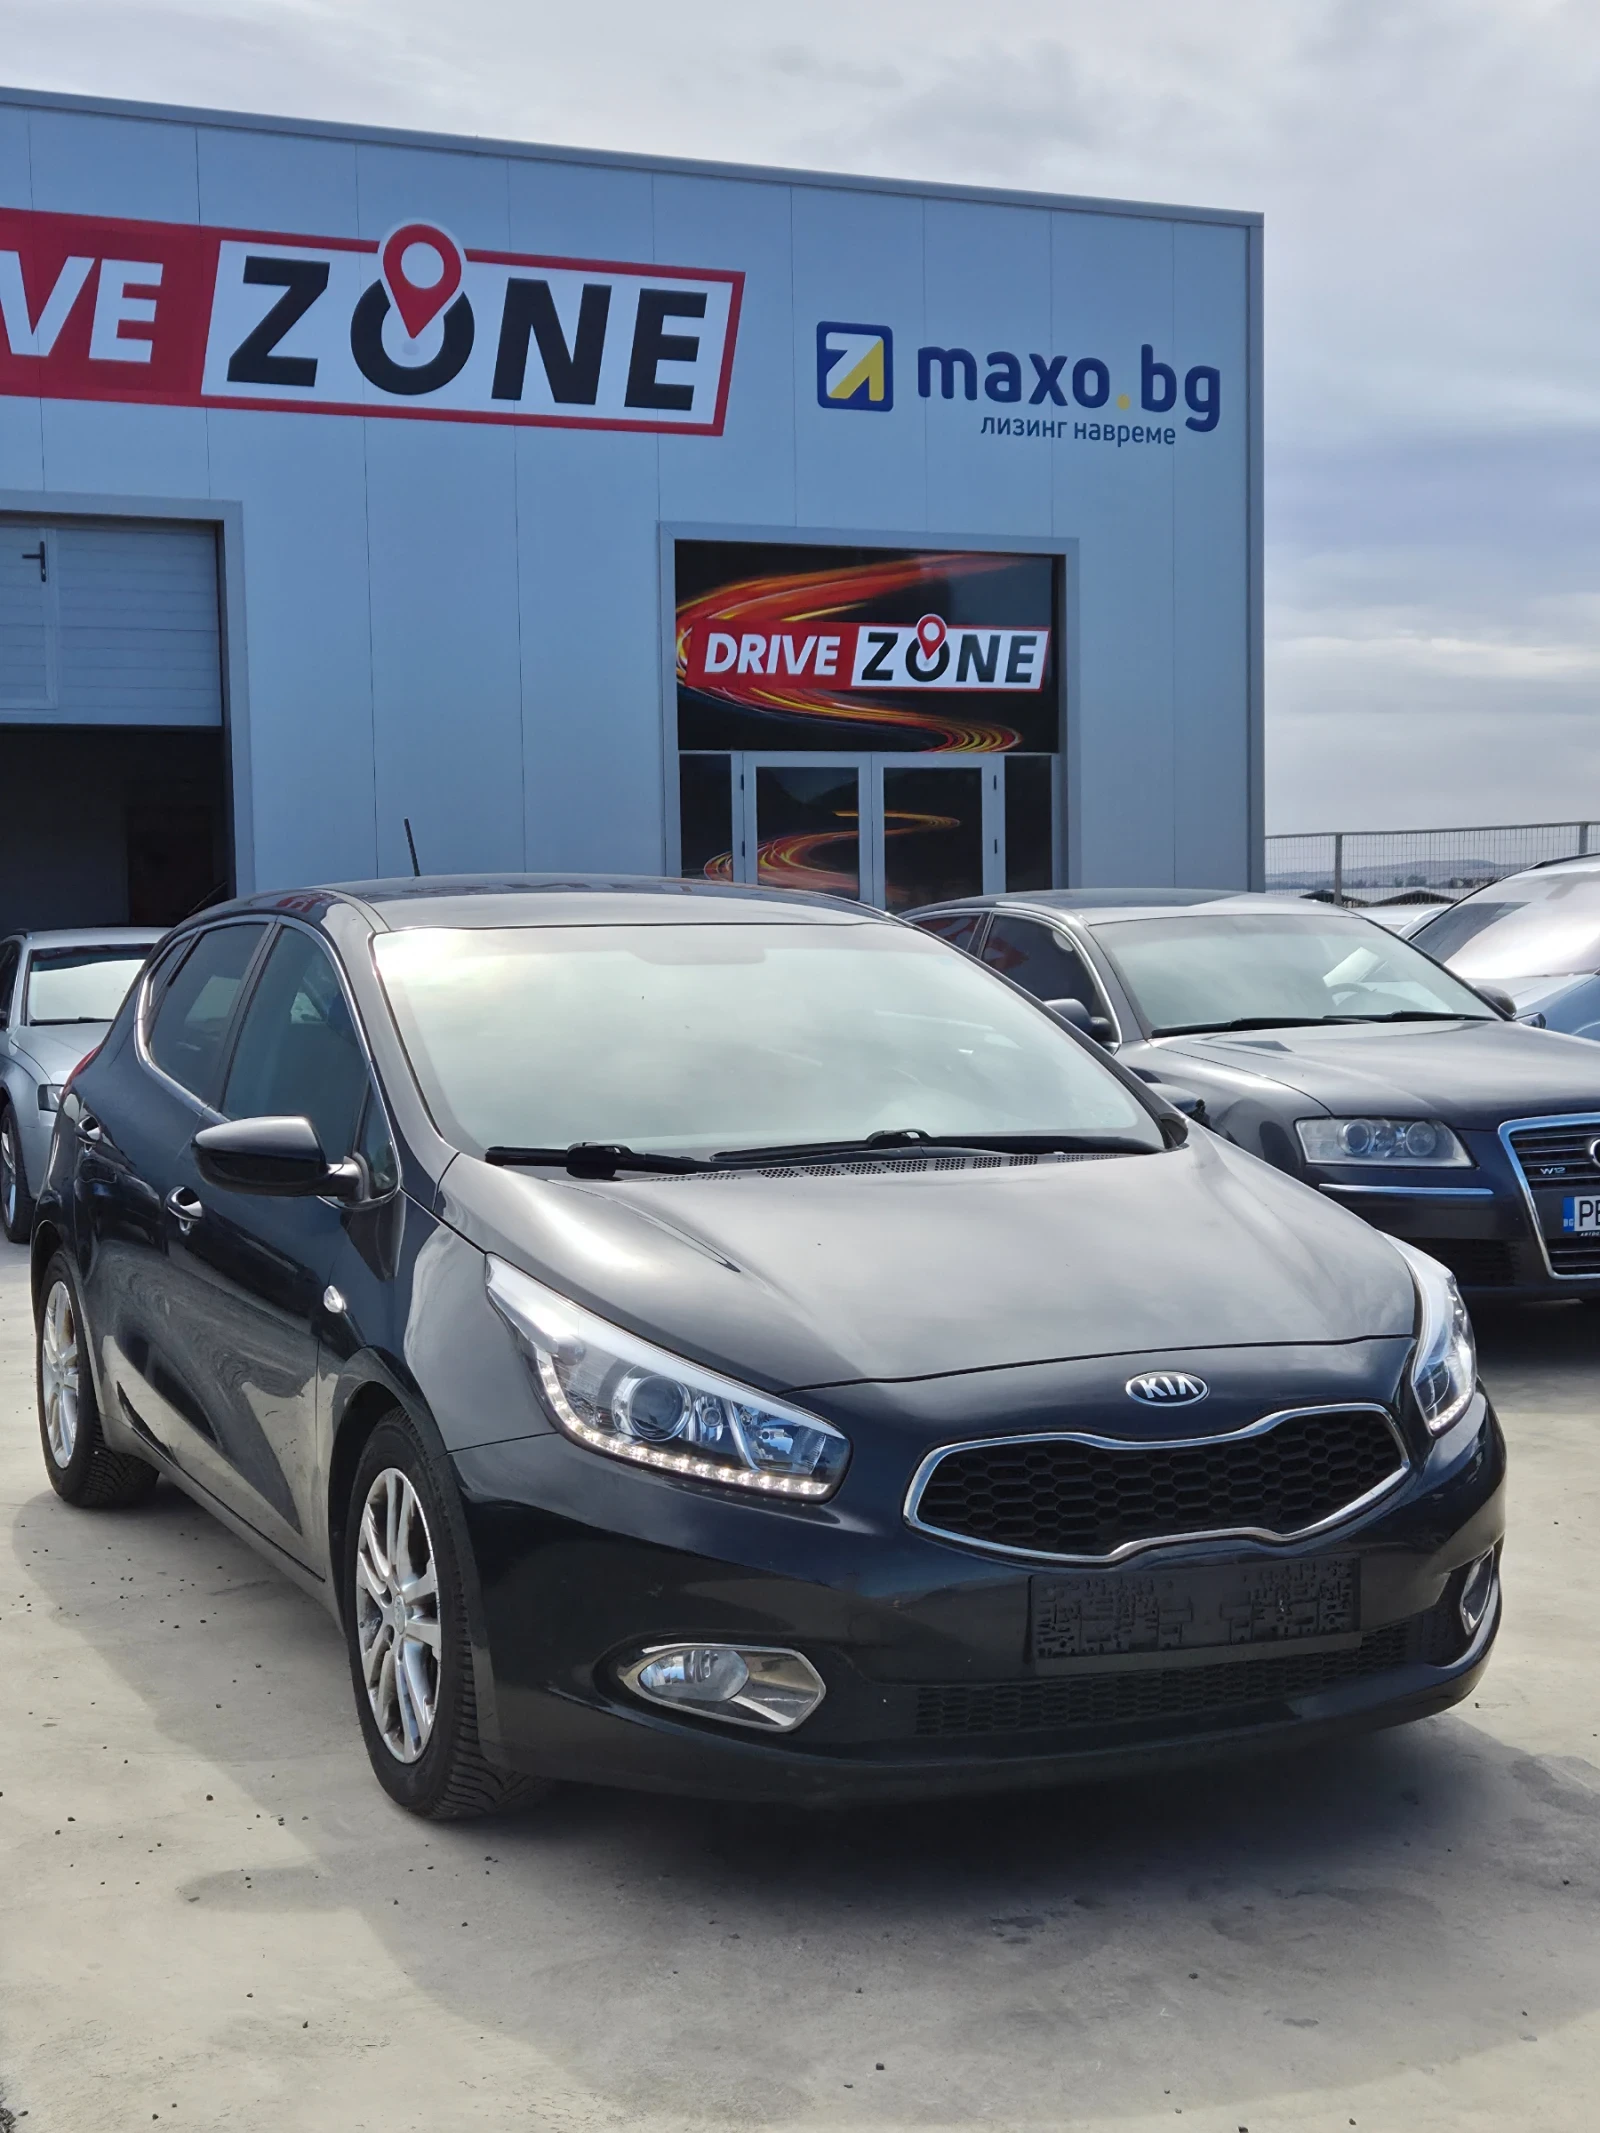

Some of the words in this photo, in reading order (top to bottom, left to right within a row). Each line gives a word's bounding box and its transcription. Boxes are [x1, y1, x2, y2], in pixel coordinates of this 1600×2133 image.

[0, 249, 164, 364] VE
[226, 254, 709, 412] ZONE
[917, 343, 1221, 433] maxo.bg
[980, 416, 1068, 439] лизинг
[1073, 421, 1177, 448] навреме
[703, 632, 842, 676] DRIVE
[860, 631, 1038, 684] ZONE
[1540, 1166, 1566, 1175] W12
[1137, 1375, 1200, 1399] KIA
